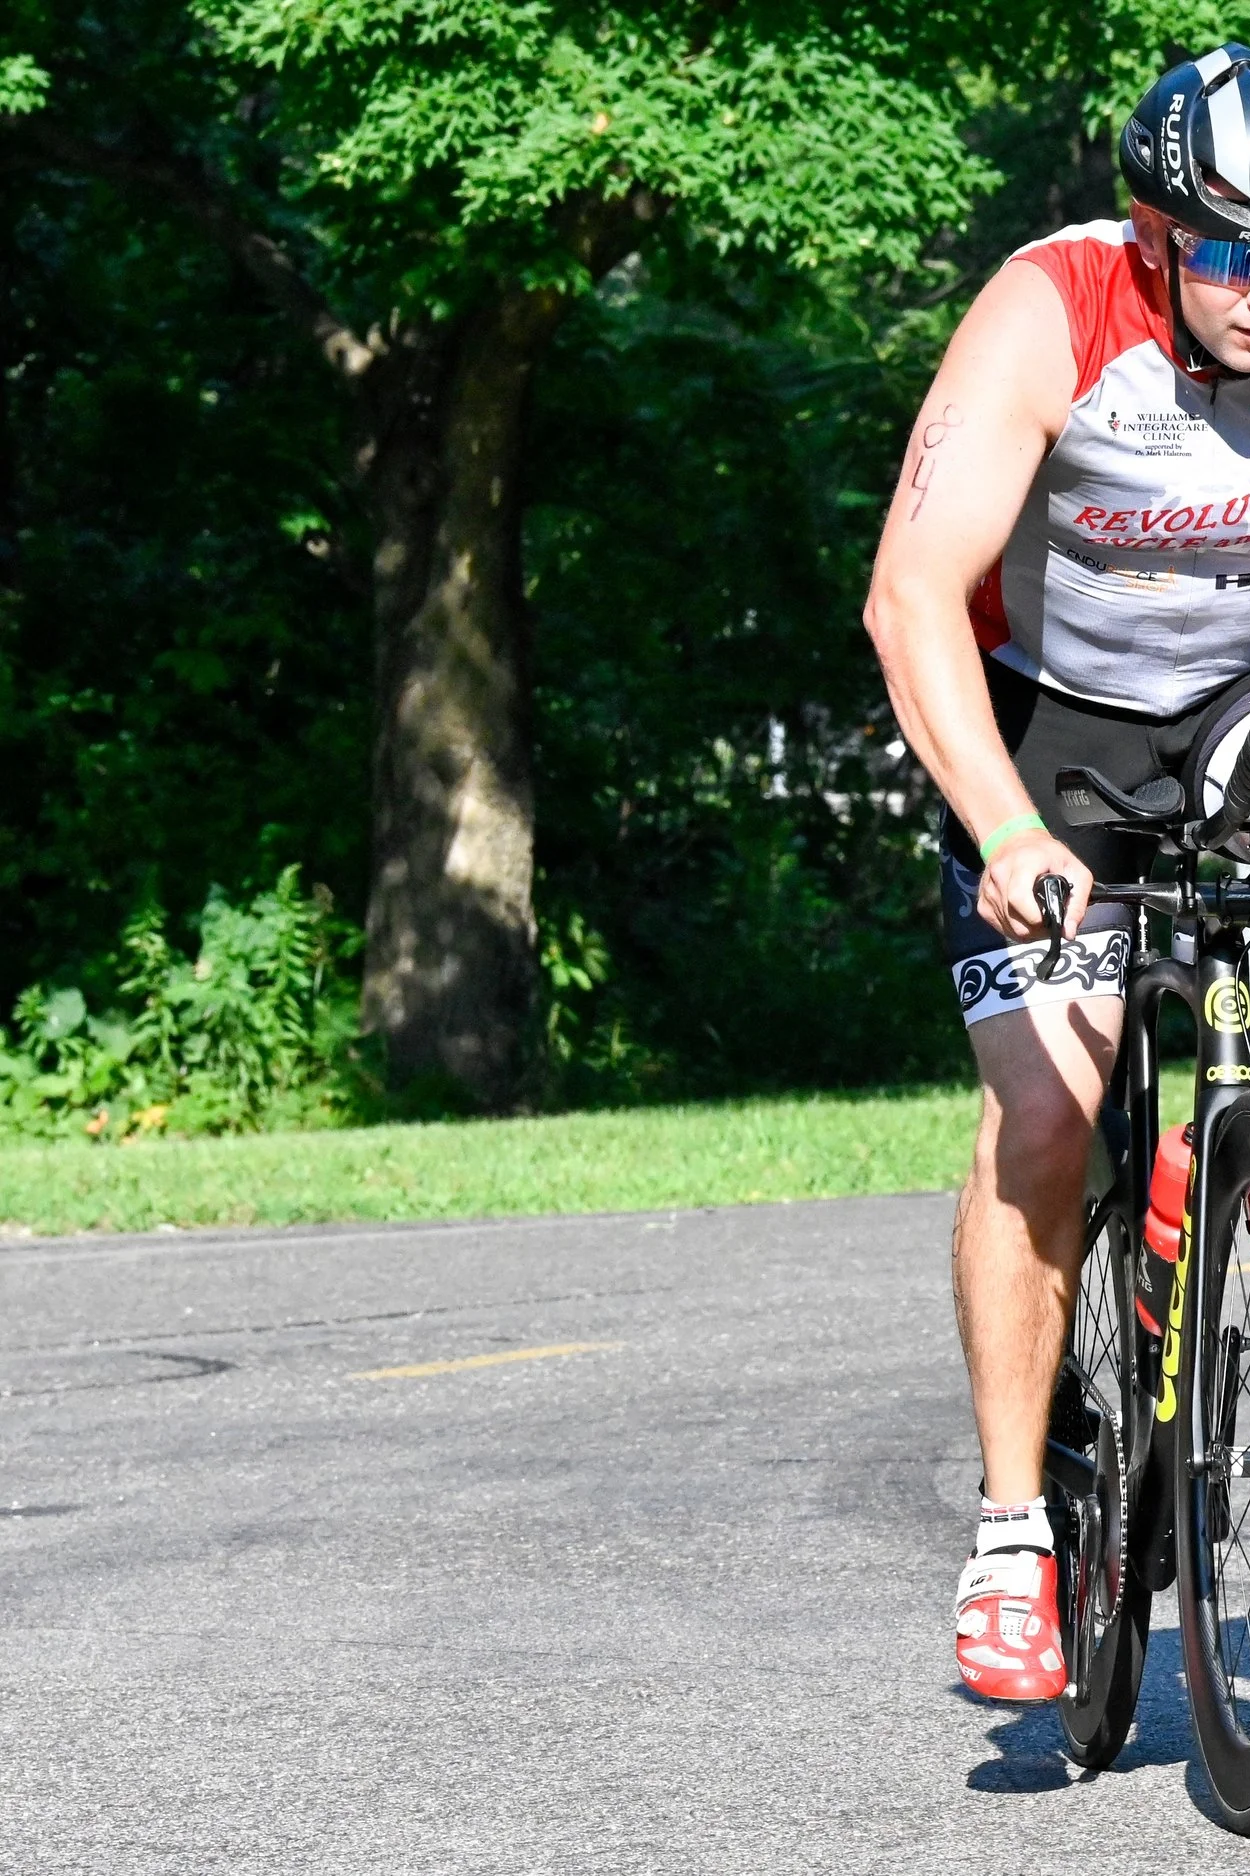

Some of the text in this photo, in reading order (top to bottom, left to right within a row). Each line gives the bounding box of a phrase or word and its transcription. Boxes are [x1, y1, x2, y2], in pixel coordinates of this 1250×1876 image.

[1166, 94, 1189, 197] RUDY
[1137, 413, 1196, 421] WILLIAMS
[1123, 423, 1209, 432] INTEGRACARE
[1142, 433, 1186, 441] CLINIC
[1144, 443, 1183, 451] supported by
